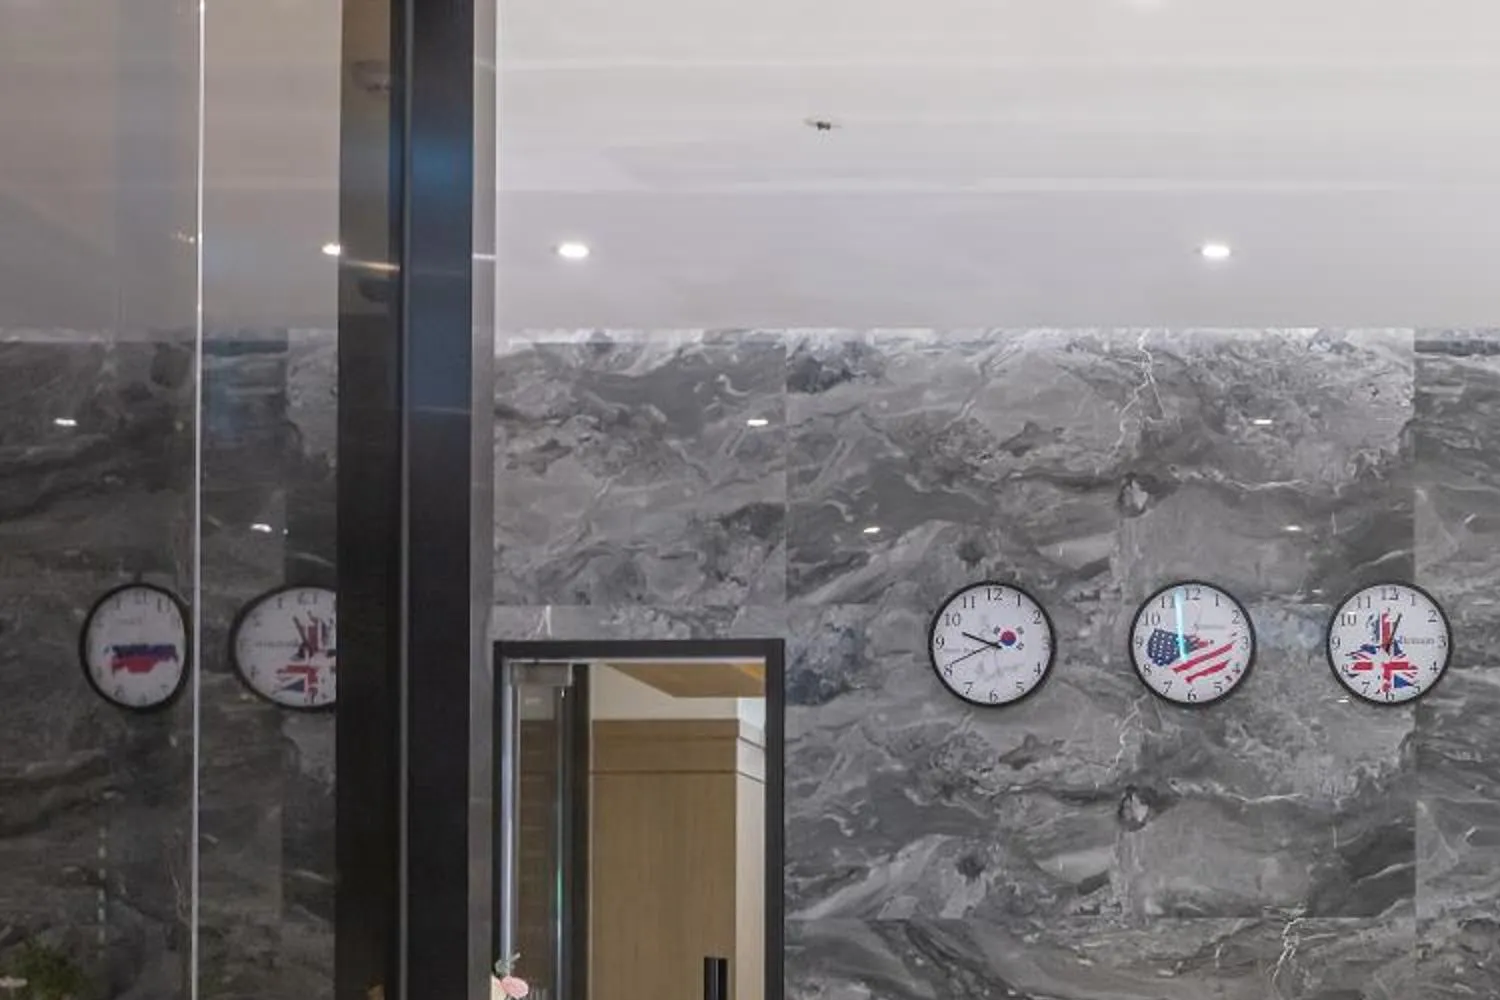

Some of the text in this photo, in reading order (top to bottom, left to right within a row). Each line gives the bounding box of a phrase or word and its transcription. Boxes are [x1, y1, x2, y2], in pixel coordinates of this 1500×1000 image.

[986, 588, 1003, 601] 12
[1017, 593, 1021, 607] 1
[1185, 588, 1201, 601] 12
[1215, 593, 1219, 607] 1
[1381, 587, 1399, 601] 12
[1410, 593, 1416, 606] 1
[963, 596, 975, 609] 11
[1357, 596, 1371, 609] 11
[944, 611, 961, 627] 10
[1033, 609, 1041, 625] 2
[1232, 609, 1240, 625] 2
[1341, 612, 1357, 627] 10
[1427, 609, 1437, 623] 2
[935, 635, 945, 649] 9
[1331, 636, 1341, 649] 9
[1438, 634, 1447, 648] 3
[943, 663, 953, 677] 8
[1143, 663, 1152, 677] 8
[1232, 663, 1241, 674] 4
[1429, 661, 1439, 674] 4
[963, 681, 973, 695] 7
[1015, 681, 1025, 693] 5
[1163, 680, 1173, 695] 7
[1213, 681, 1223, 693] 5
[1361, 681, 1370, 695] 7
[989, 687, 998, 704] 6
[1187, 688, 1197, 703] 6
